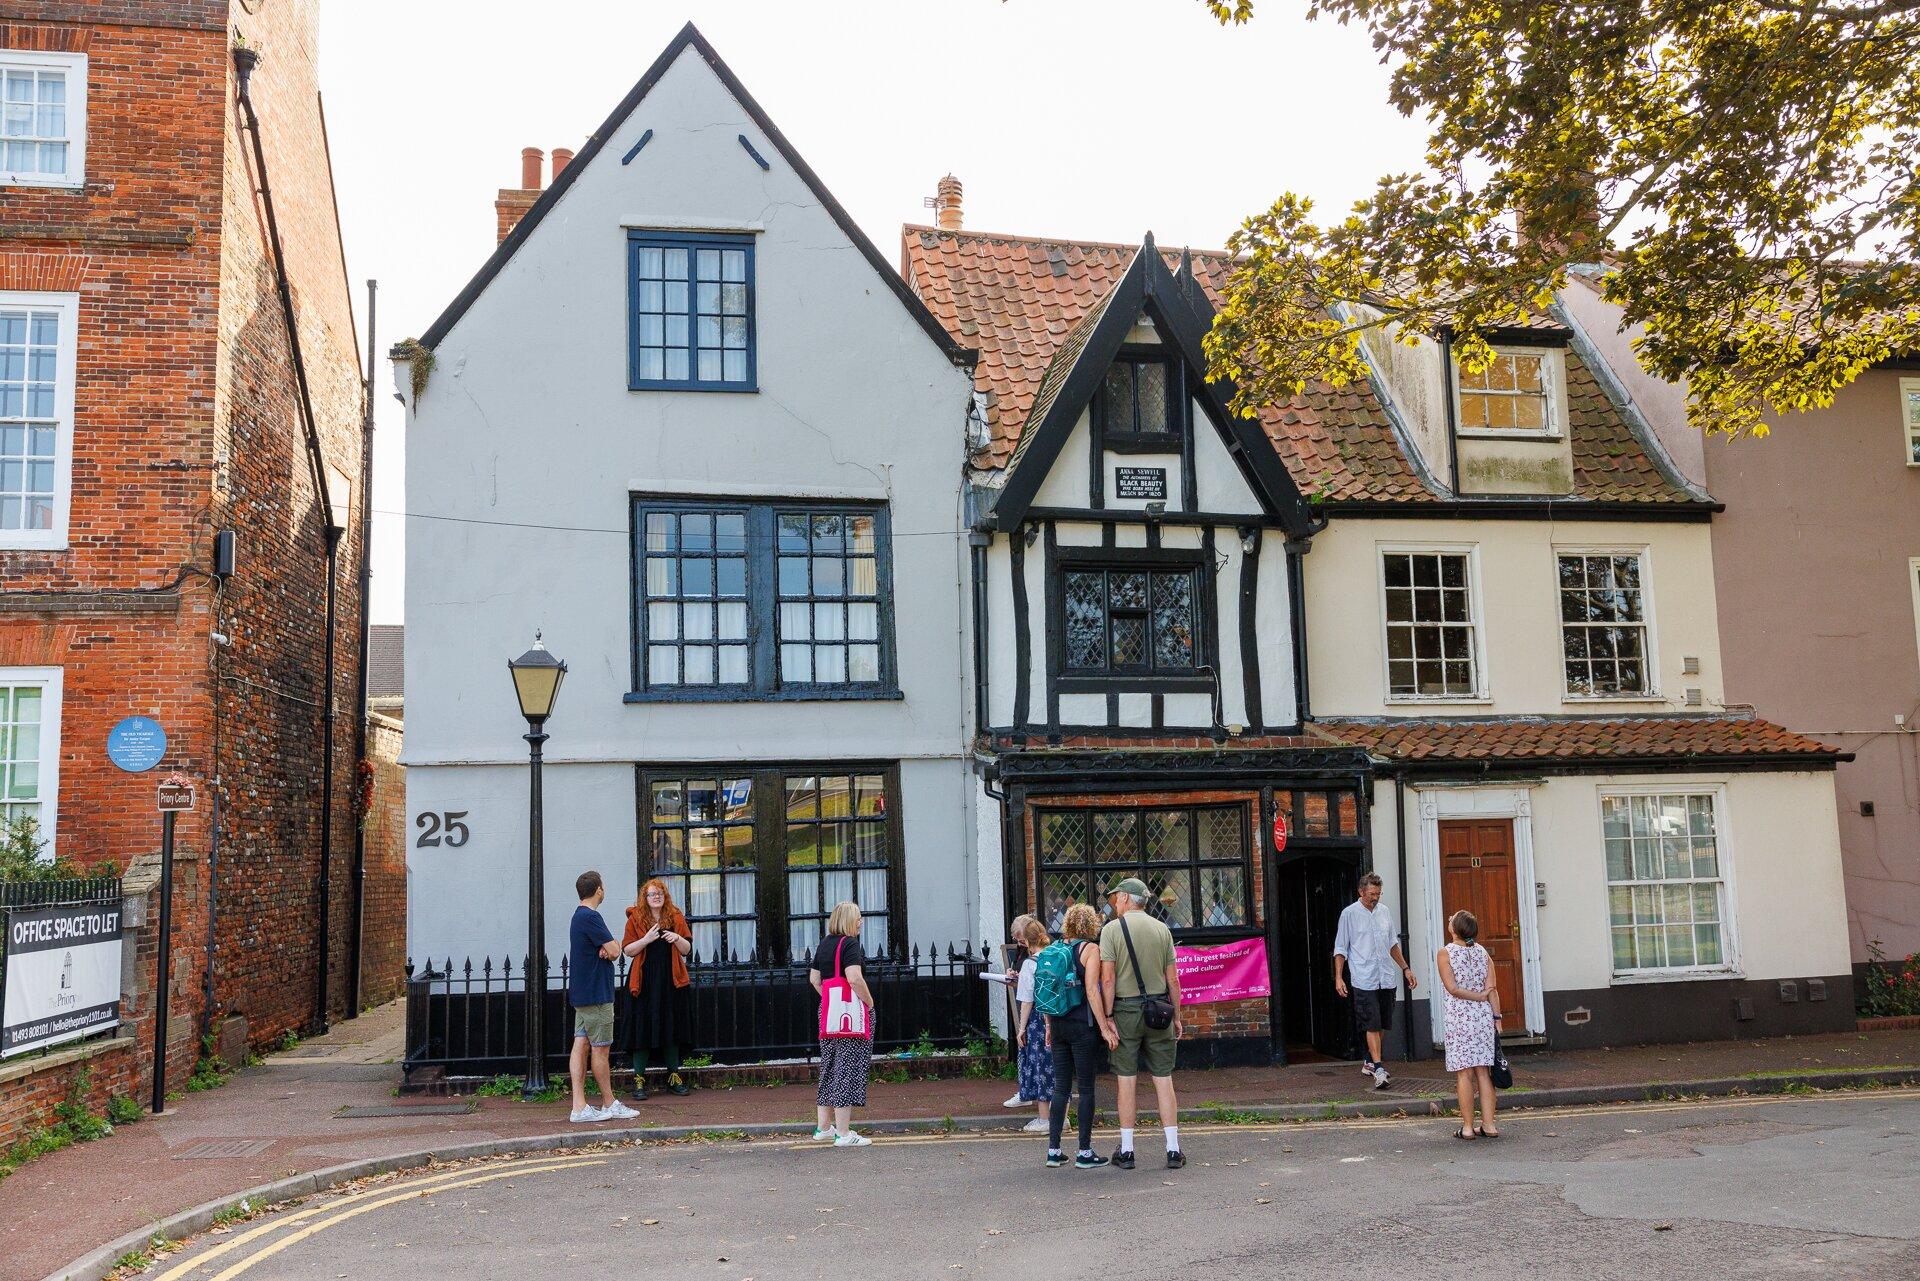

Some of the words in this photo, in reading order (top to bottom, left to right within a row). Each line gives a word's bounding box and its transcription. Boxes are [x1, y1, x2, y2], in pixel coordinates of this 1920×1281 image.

[161, 792, 174, 805] Priory
[175, 792, 190, 803] Centre
[416, 810, 470, 848] 25
[14, 919, 52, 944] OFFICE
[53, 916, 85, 940] SPACE
[85, 914, 100, 935] TO
[102, 912, 118, 934] LET
[1220, 950, 1242, 959] festival
[58, 994, 75, 1008] Priory
[12, 1028, 28, 1043] 01493
[29, 1023, 48, 1038] 808101
